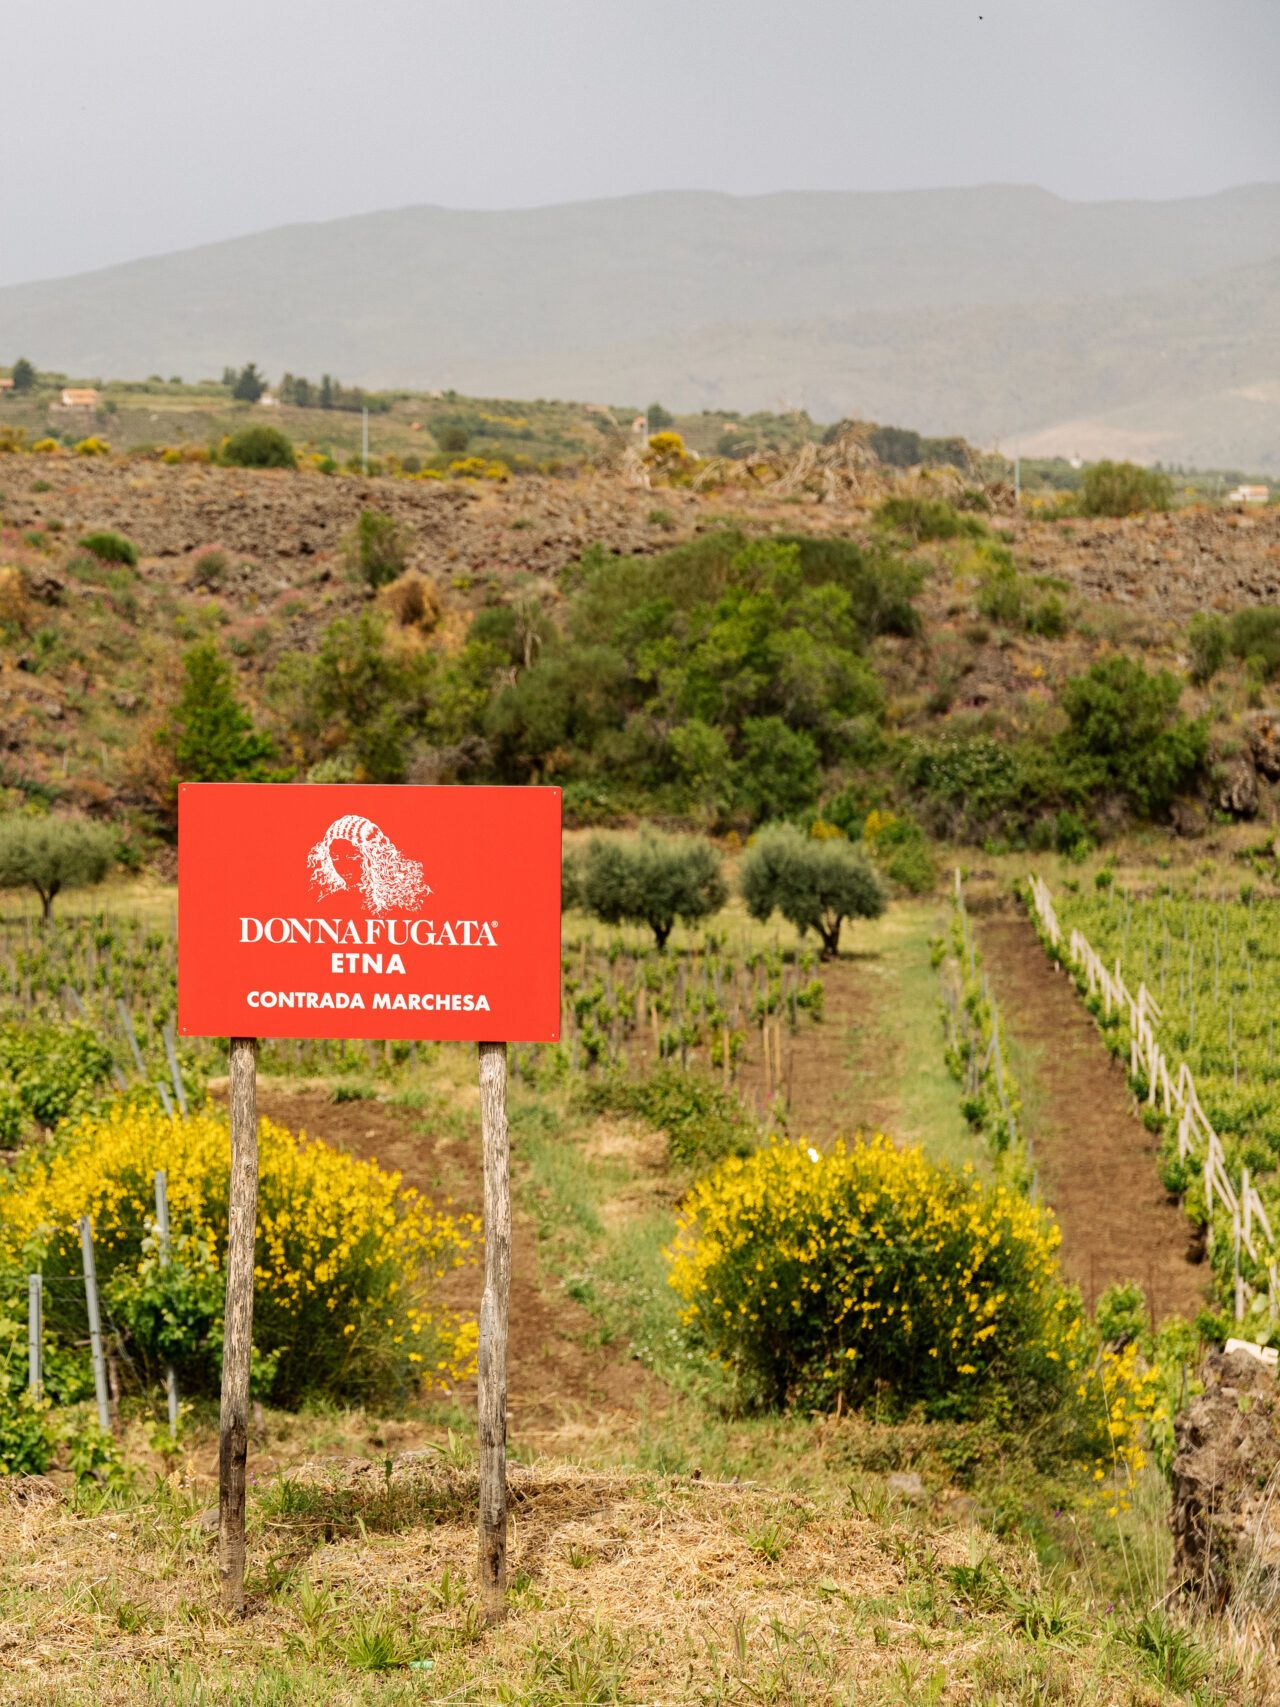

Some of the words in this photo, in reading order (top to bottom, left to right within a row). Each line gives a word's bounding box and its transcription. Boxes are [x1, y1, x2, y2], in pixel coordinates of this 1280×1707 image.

[331, 953, 406, 974] ETNA
[246, 991, 365, 1009] CONTRADA
[372, 993, 490, 1011] MARCHESA
